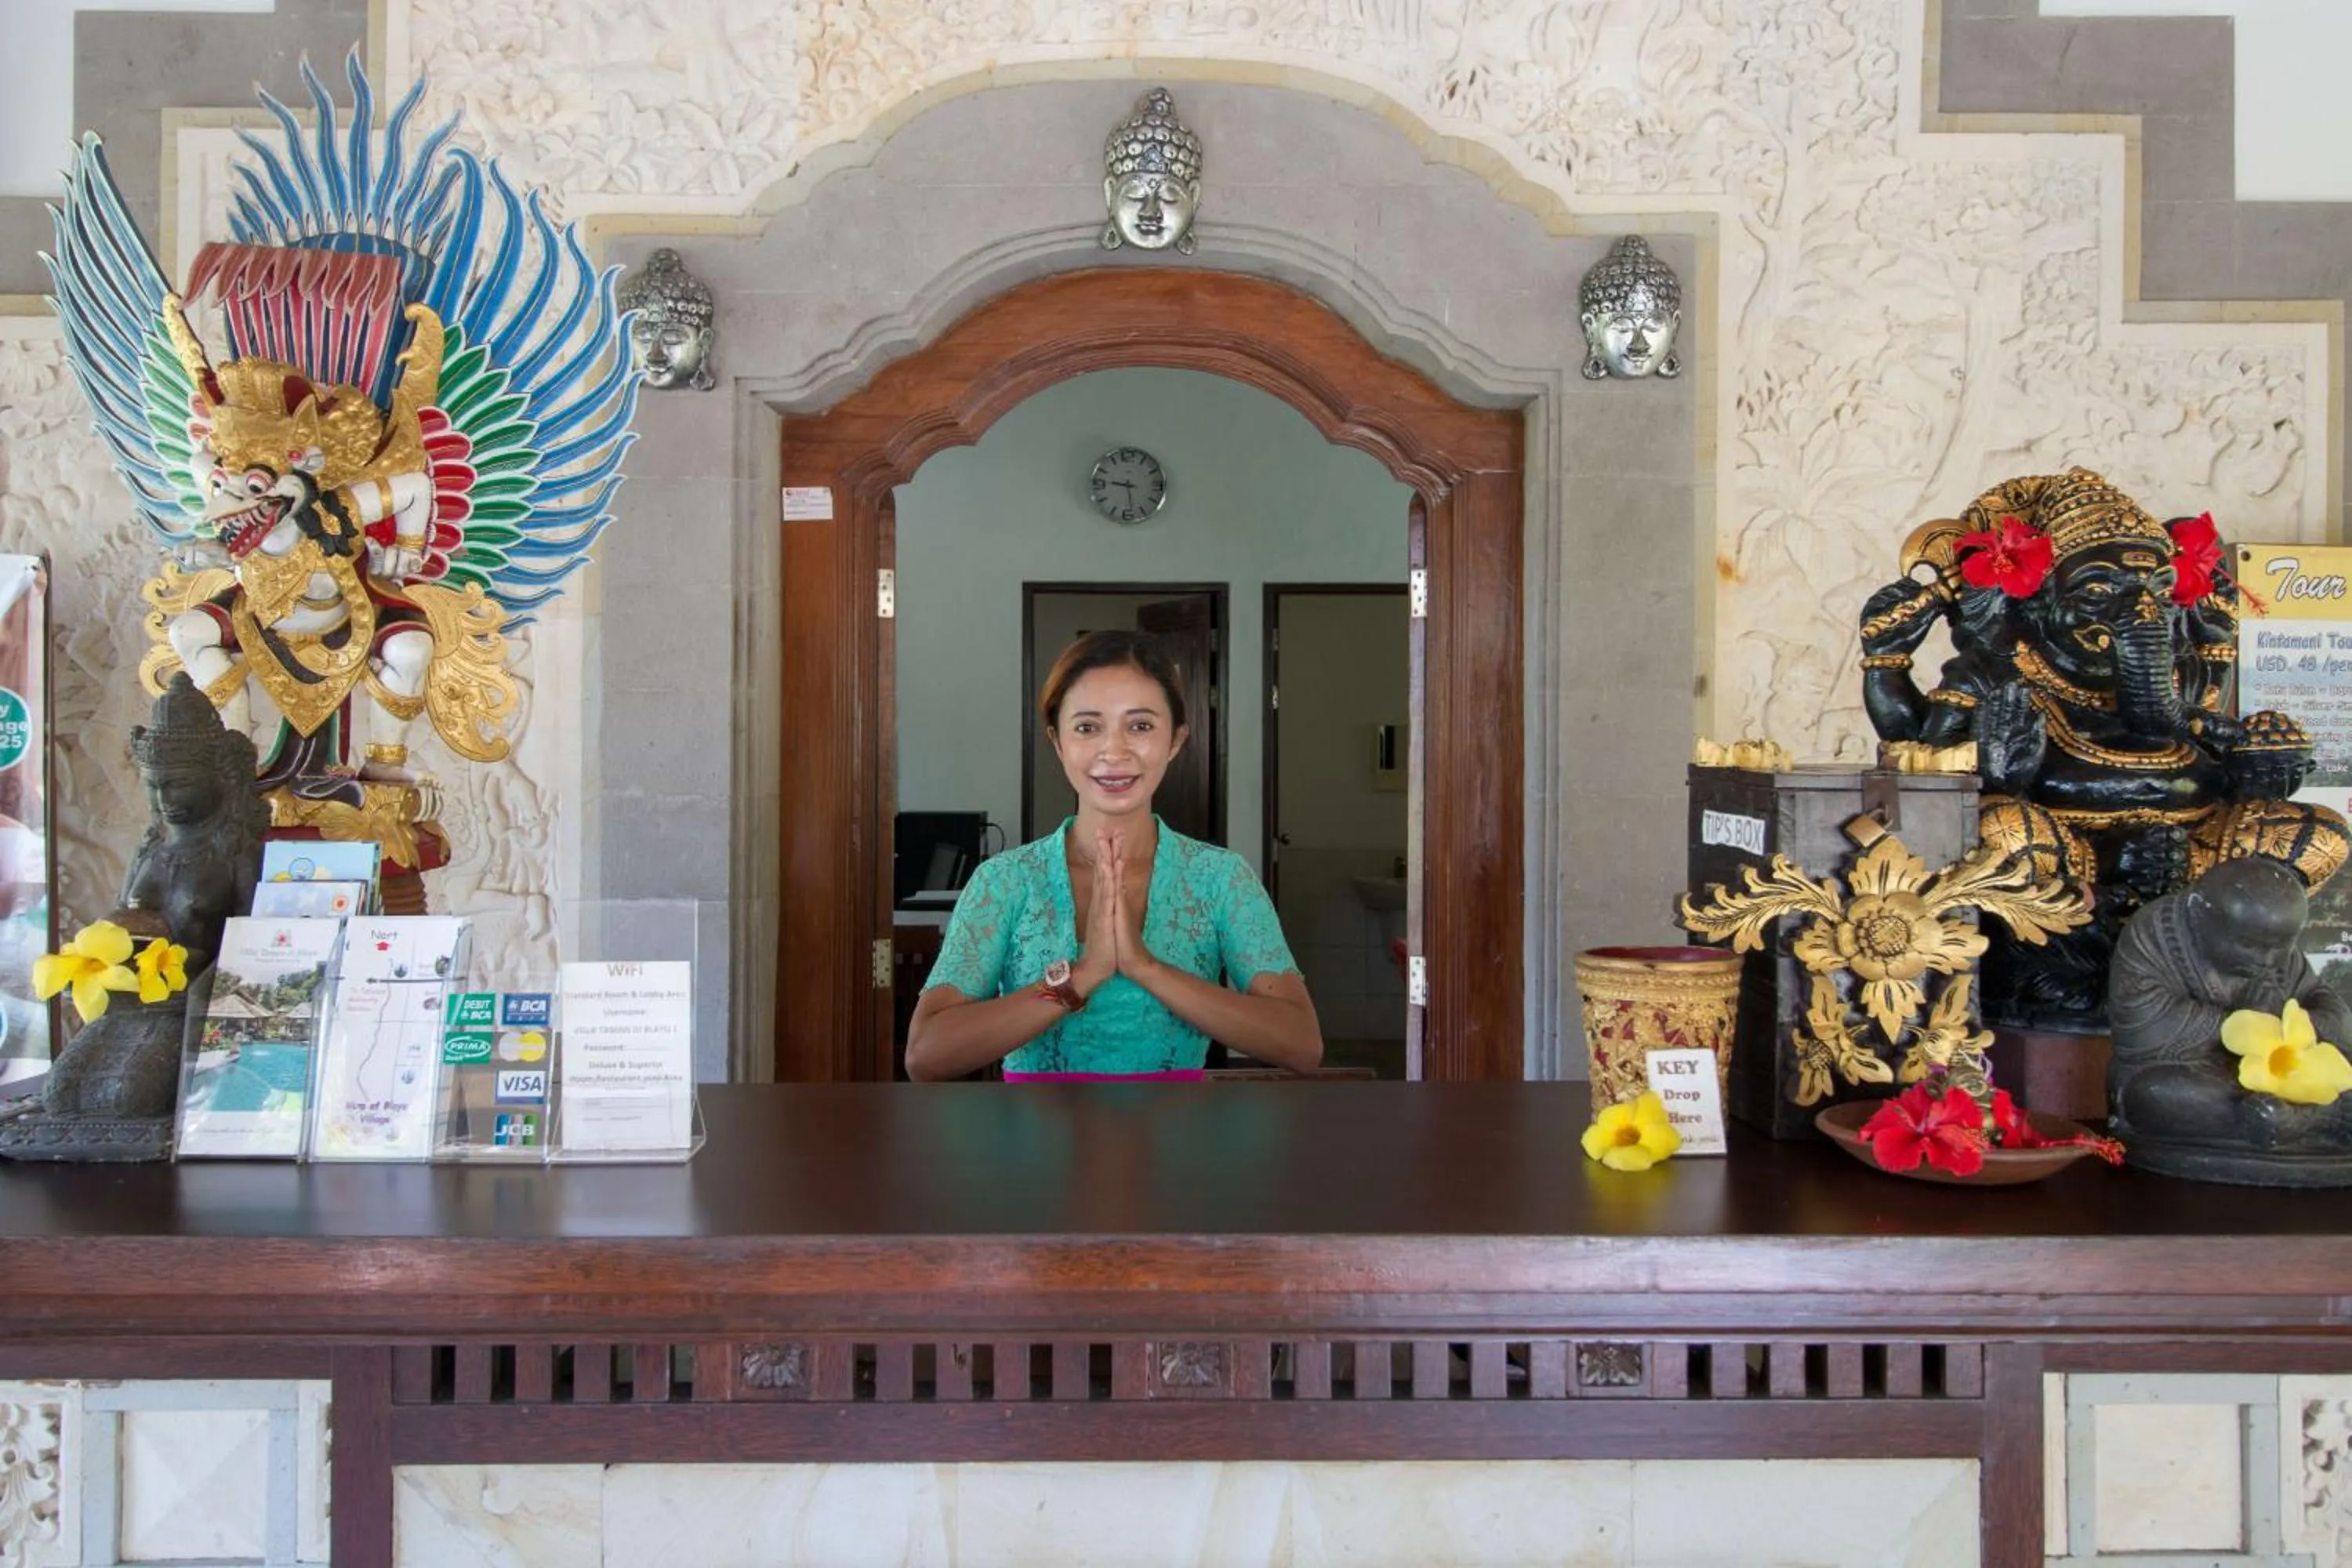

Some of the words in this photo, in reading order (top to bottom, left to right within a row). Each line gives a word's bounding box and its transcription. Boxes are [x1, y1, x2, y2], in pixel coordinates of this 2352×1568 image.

[2265, 557, 2346, 602] Tour
[1735, 818, 1762, 851] BOX
[606, 964, 644, 977] WiFi
[464, 1000, 492, 1009] DEBIT
[521, 1000, 546, 1011] BCA
[470, 1011, 492, 1020] BCA
[450, 1041, 487, 1051] PRIMA
[1656, 1059, 1700, 1076] KEY
[503, 1076, 542, 1092] VISA
[1663, 1088, 1700, 1102] Drop
[1668, 1111, 1703, 1123] Here
[495, 1123, 535, 1136] JCB
